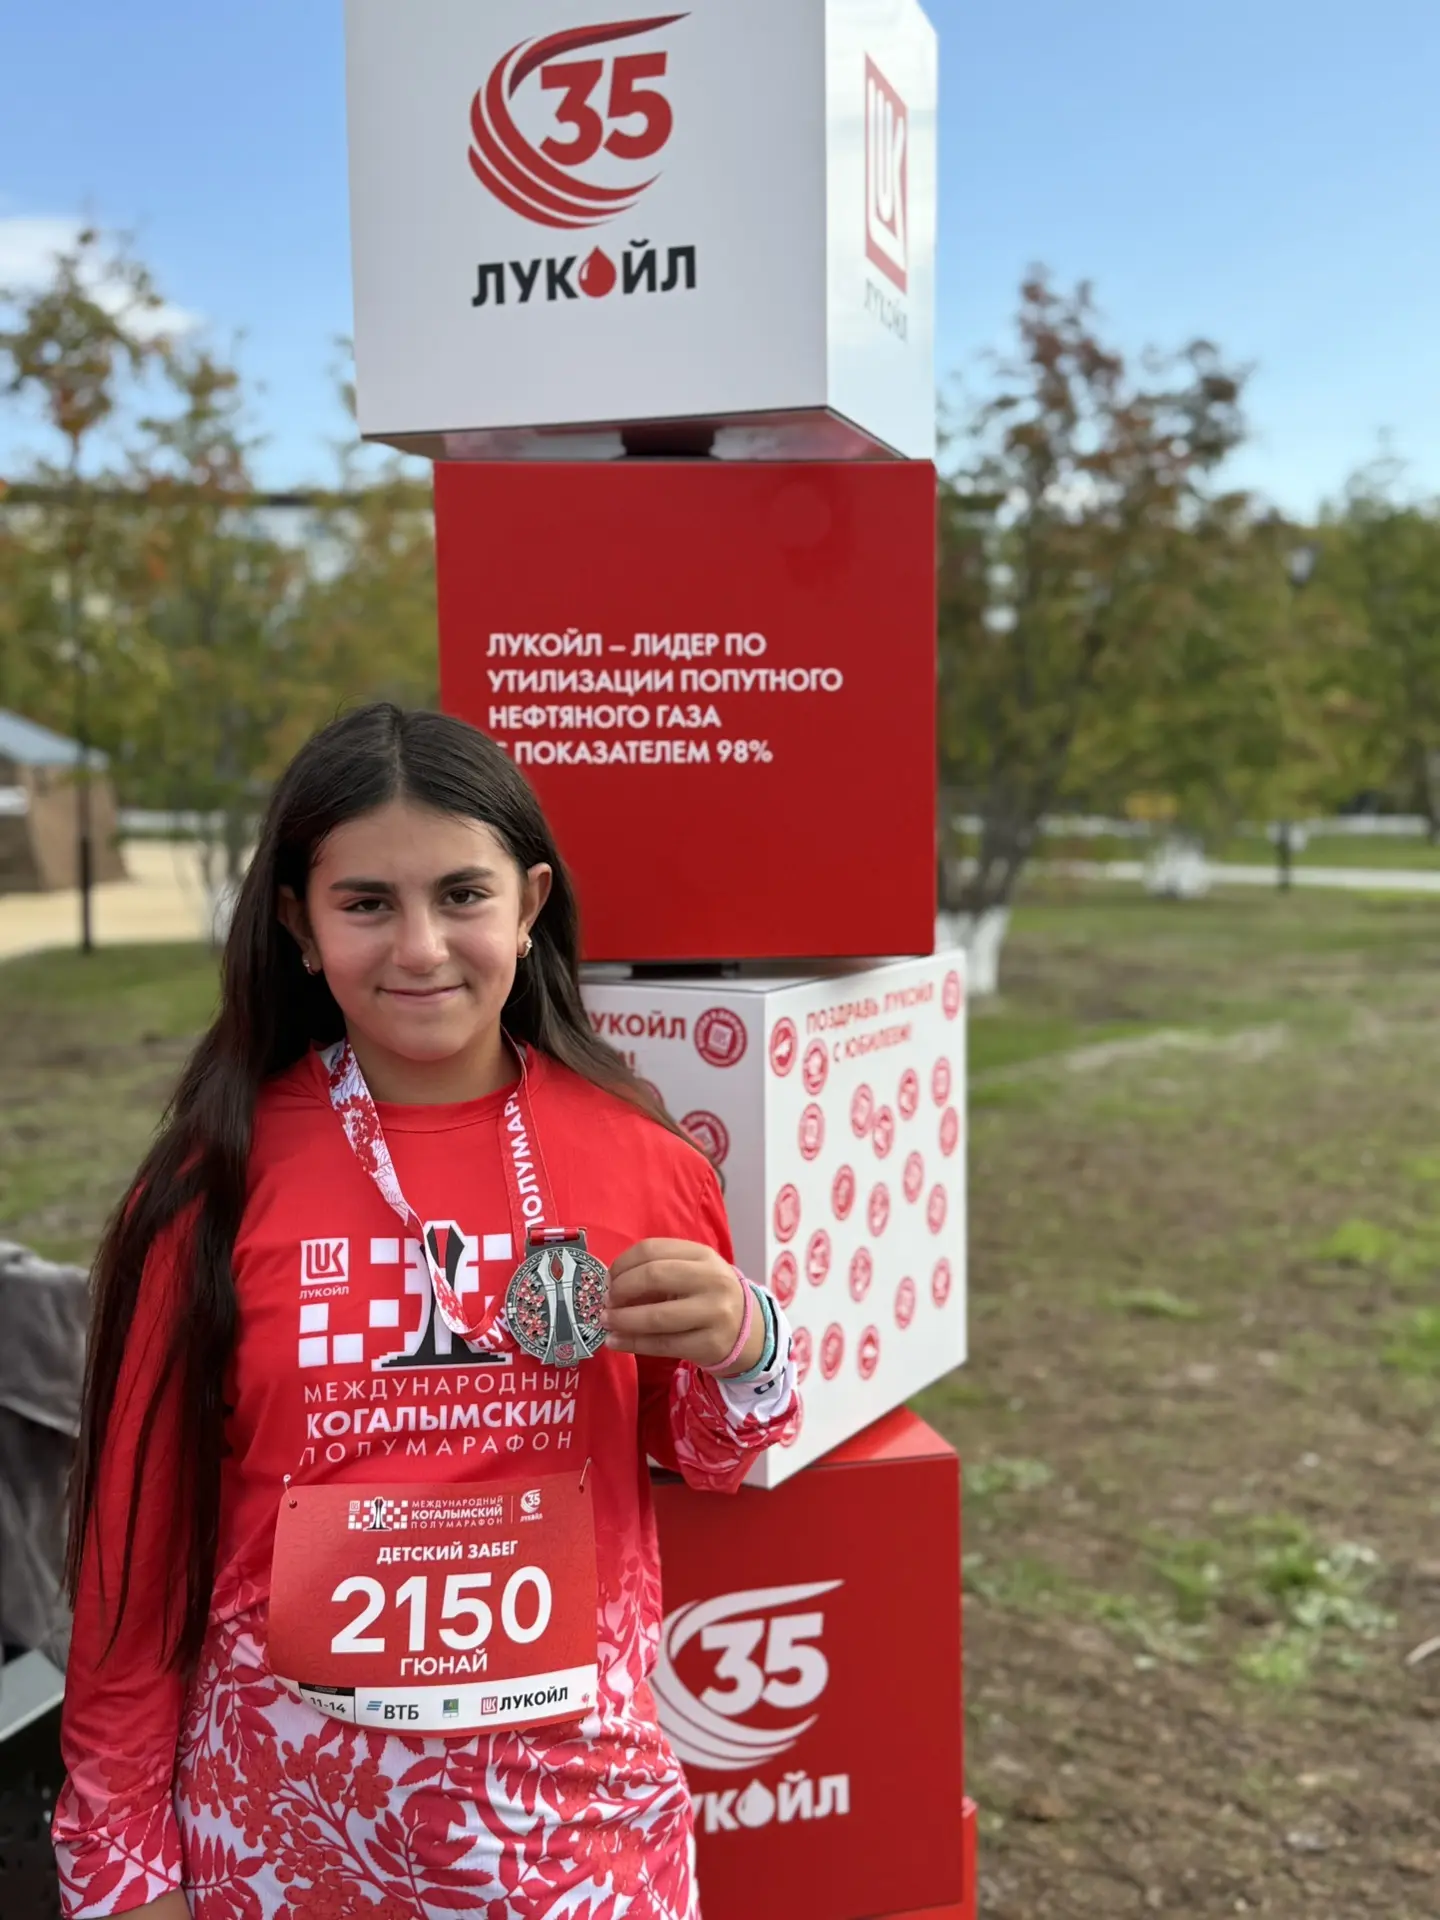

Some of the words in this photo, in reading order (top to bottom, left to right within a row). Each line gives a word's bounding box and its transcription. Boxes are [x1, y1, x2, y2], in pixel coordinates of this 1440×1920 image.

[539, 51, 673, 166] 35
[471, 239, 697, 307] ЛУКОЙЛ
[486, 628, 603, 658] ЛУКОЙЛ
[631, 633, 720, 660] ЛИДЕР
[725, 632, 767, 657] ПО
[487, 669, 674, 697] УТИЛИЗАЦИИ
[680, 668, 844, 693] ПОПУТНОГО
[488, 705, 651, 729] НЕФТЯНОГО
[657, 704, 722, 729] ГАЗА
[514, 740, 711, 765] ПОКАЗАТЕЛЕМ
[717, 740, 773, 763] 98%
[590, 1010, 687, 1040] УКОЙЛ
[806, 998, 880, 1035] ПОЗДРАВЬ
[299, 1285, 350, 1300] ЛУКОЙЛ
[303, 1367, 580, 1404] МЕЖДУНАРОДНЫЙ
[306, 1392, 576, 1440] КОГАЛЫМСКИЙ
[299, 1431, 573, 1467] ПОЛУМАРАФОН
[411, 1495, 504, 1508] МЕЖДУНАРОДНЫЙ
[411, 1504, 503, 1520] КОГАЛЫМСКИЙ
[527, 1492, 541, 1506] 35
[411, 1518, 503, 1529] ПОЛУМАРАФОН
[376, 1541, 463, 1565] ДЕТСКИЙ
[468, 1539, 519, 1559] ЗАБЕГ
[330, 1565, 553, 1654] 2150
[400, 1648, 488, 1677] ГЮНАЙ
[700, 1611, 830, 1716] 35
[309, 1697, 346, 1713] 11-14
[384, 1704, 420, 1720] ВТБ
[500, 1686, 568, 1711] ЛУКОЙЛ
